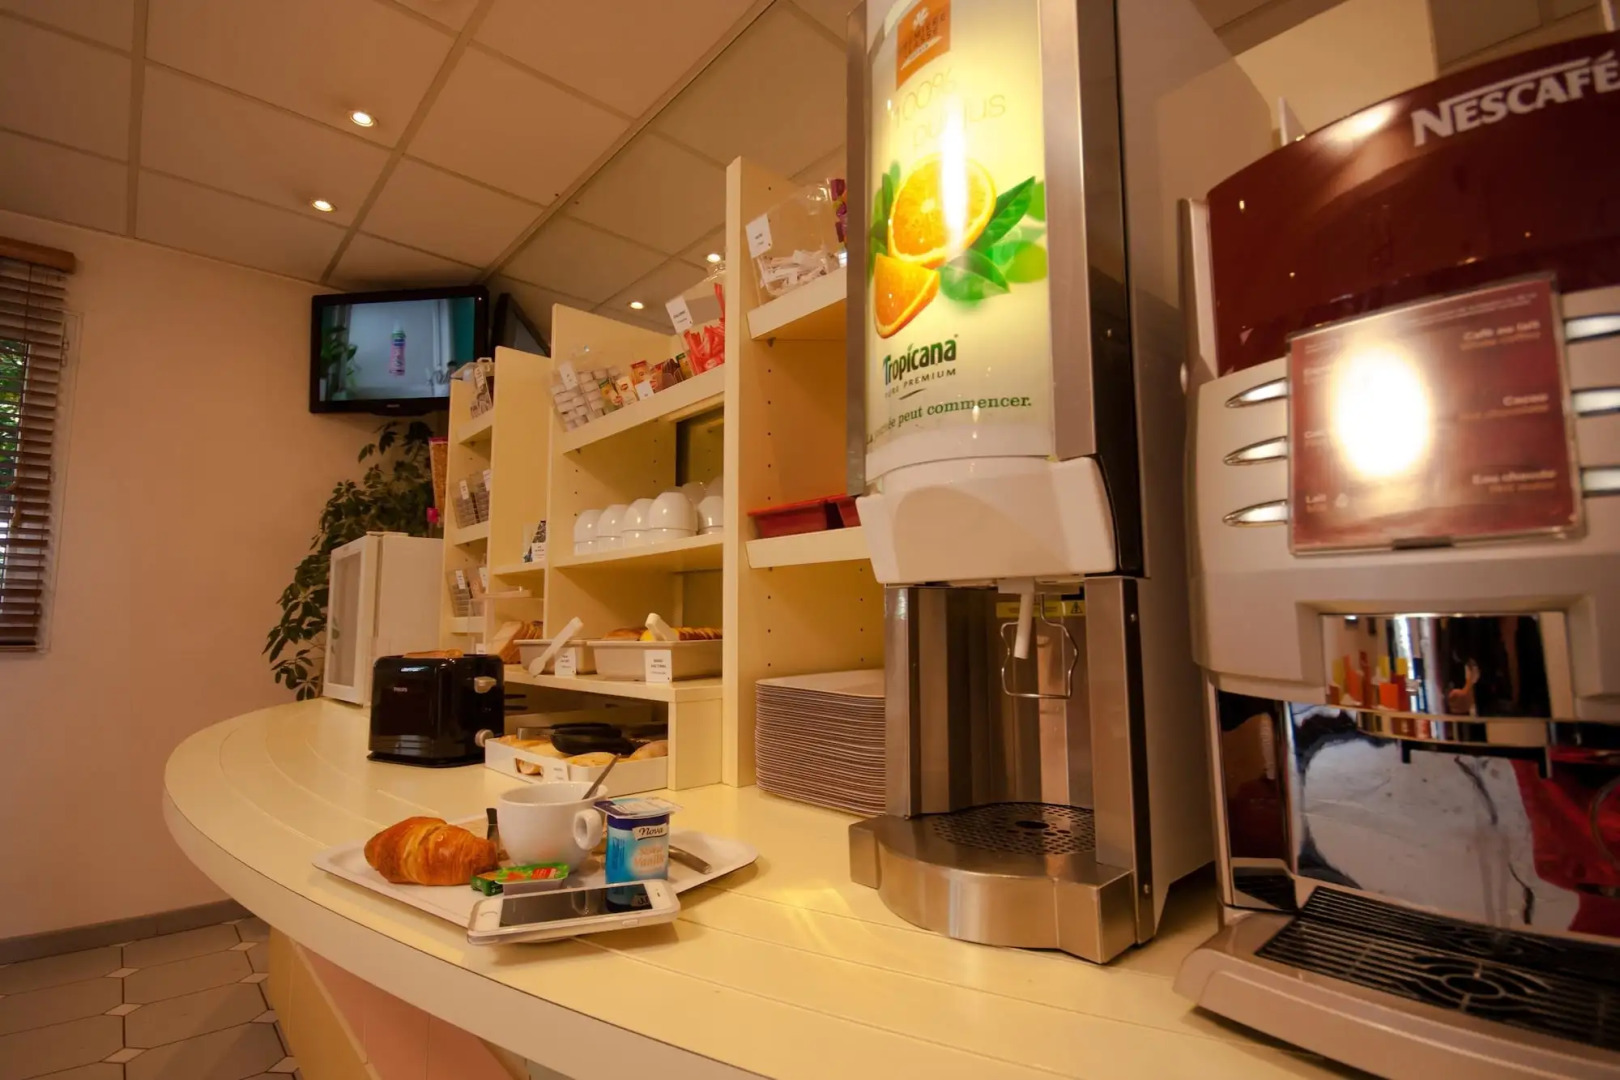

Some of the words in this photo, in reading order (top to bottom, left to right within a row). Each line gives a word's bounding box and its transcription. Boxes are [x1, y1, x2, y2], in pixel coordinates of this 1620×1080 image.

[1410, 49, 1620, 147] NESCAFÉ
[883, 338, 957, 386] Tropicana
[903, 367, 957, 389] PREMIUM
[898, 406, 923, 428] peut
[927, 395, 1032, 415] commencer.
[638, 826, 664, 837] Nova
